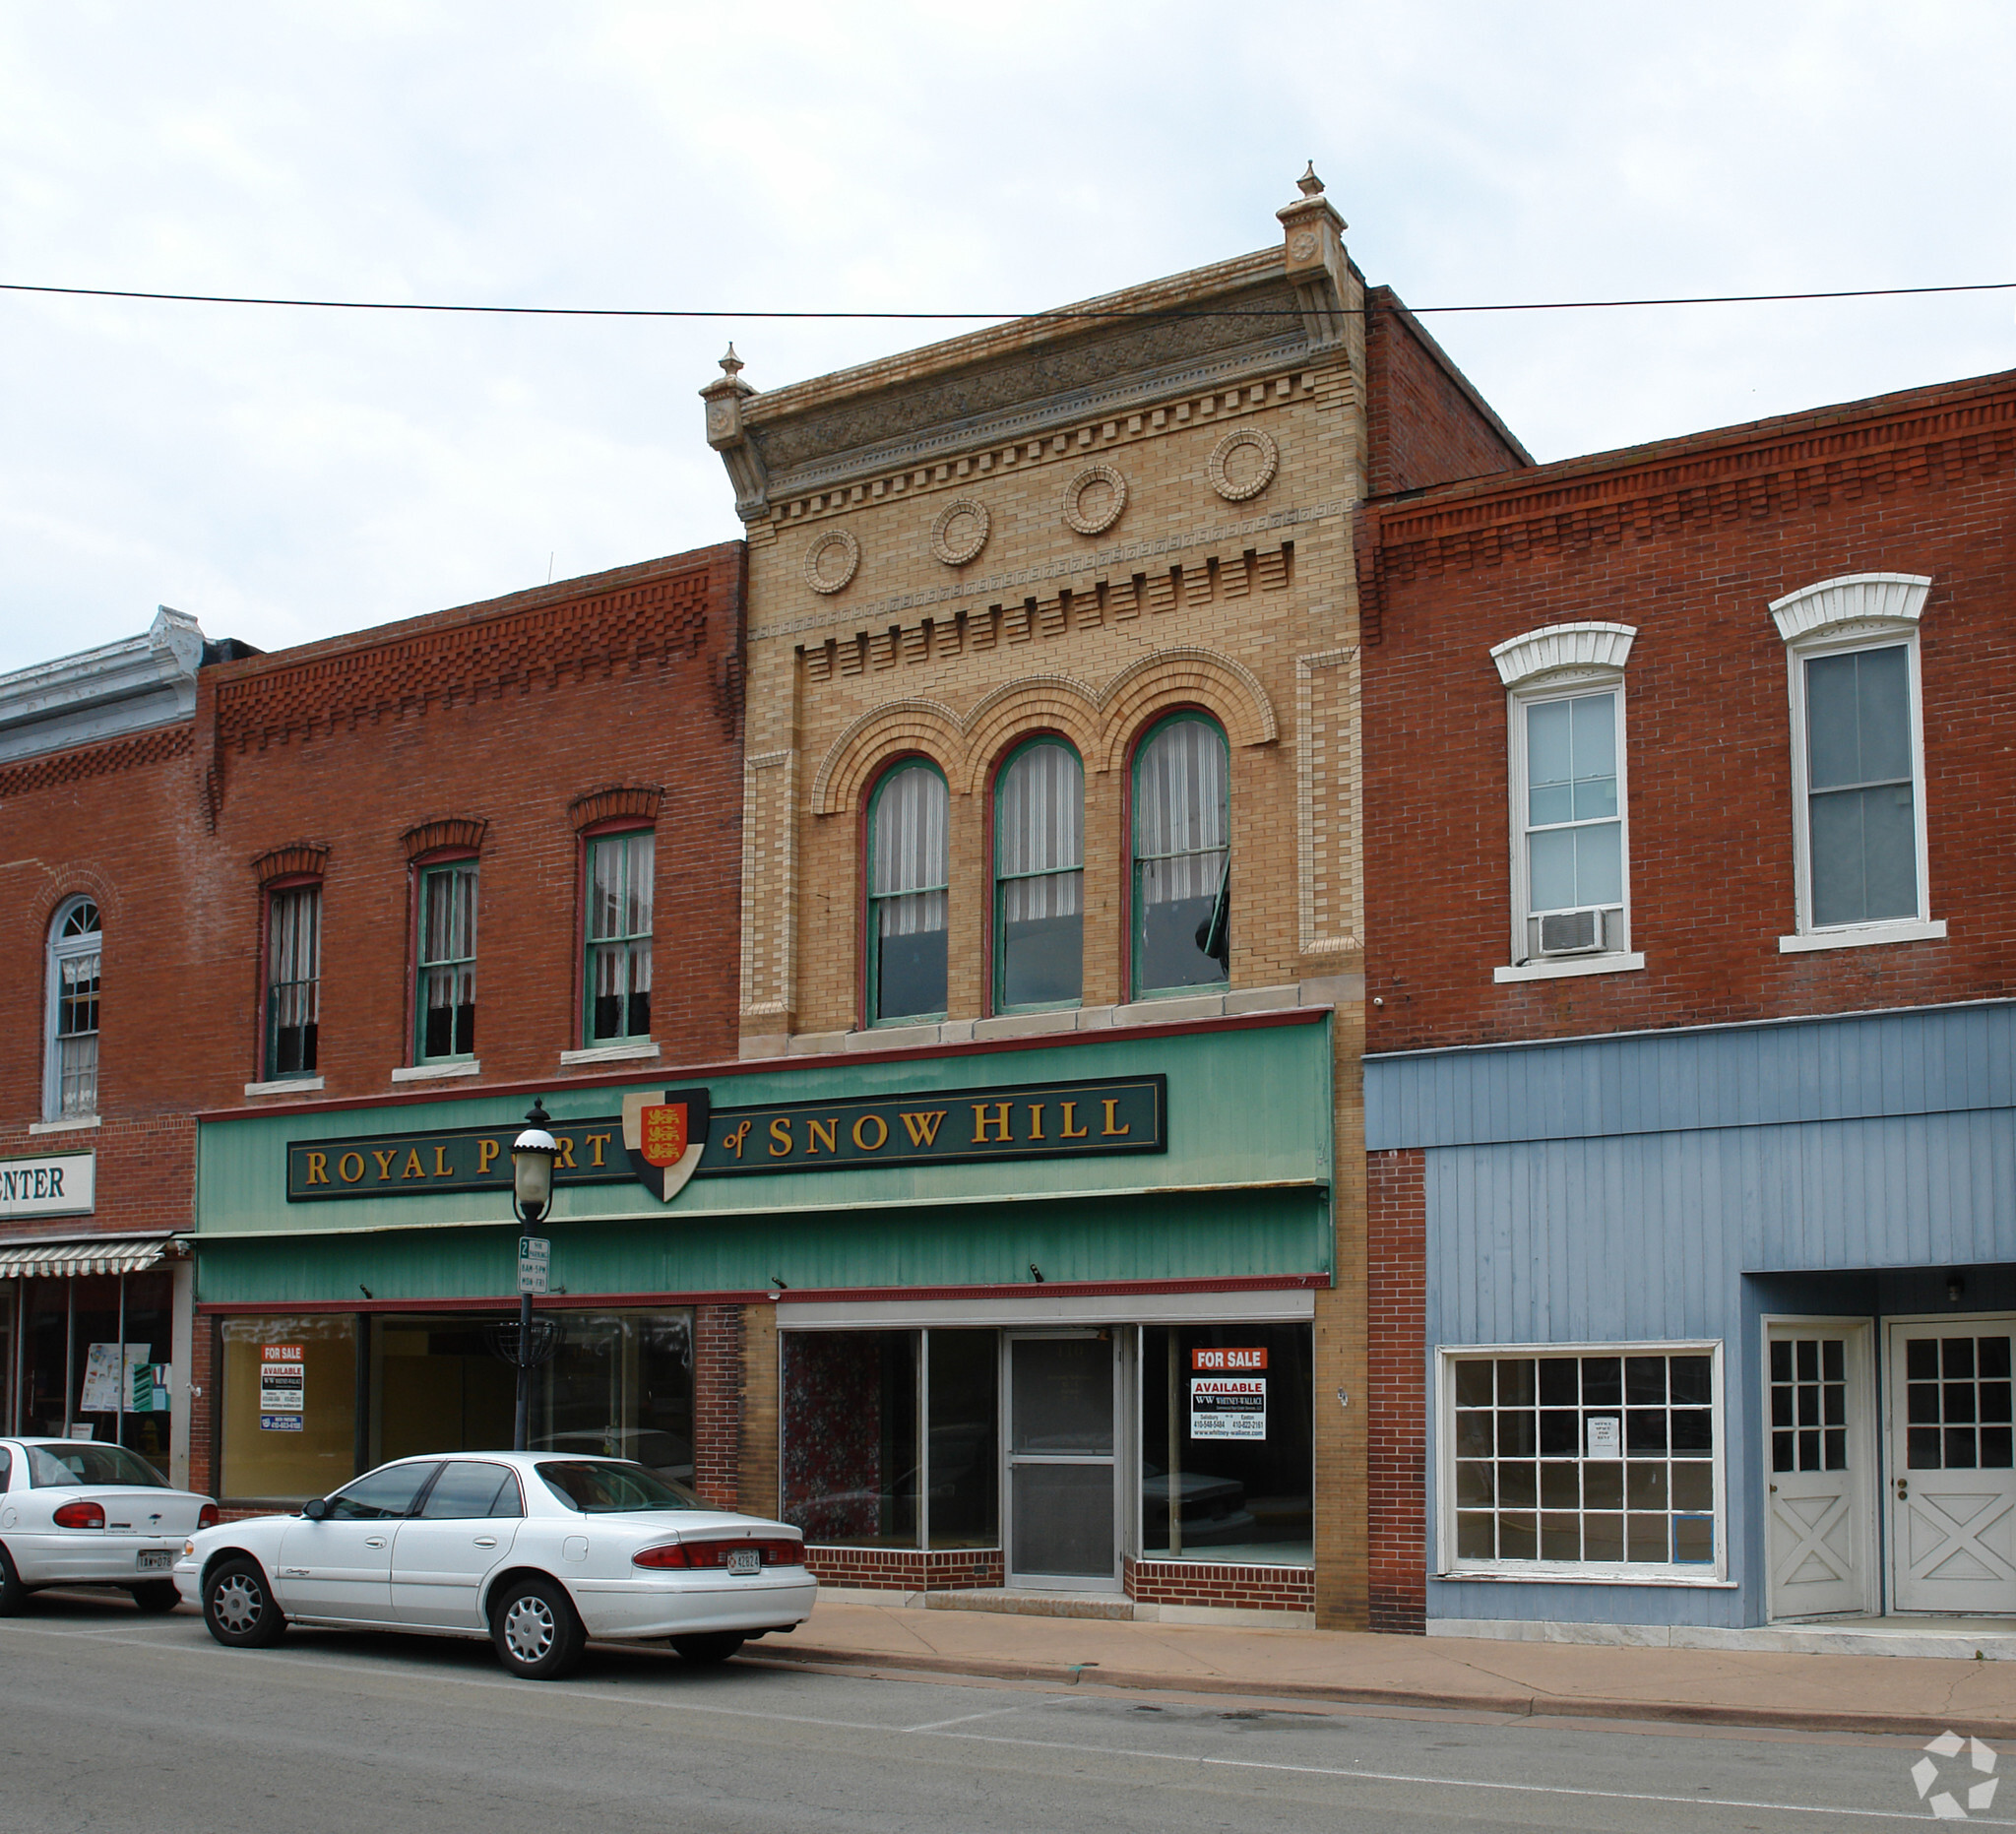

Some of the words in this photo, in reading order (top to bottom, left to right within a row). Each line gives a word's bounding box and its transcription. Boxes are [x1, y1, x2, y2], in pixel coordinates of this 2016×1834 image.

[305, 1144, 455, 1185] ROYAL
[476, 1132, 612, 1174] PRT
[722, 1119, 752, 1159] of
[768, 1108, 949, 1158] SNOW
[971, 1099, 1131, 1143] HILL
[0, 1167, 65, 1201] NTER
[522, 1241, 528, 1255] 2
[264, 1347, 281, 1360] FOR
[282, 1347, 301, 1360] SALE
[1197, 1352, 1225, 1367] FOR
[1227, 1351, 1262, 1367] SALE
[1195, 1383, 1262, 1392] AVAILABLE
[1194, 1395, 1215, 1404] WW
[738, 1555, 758, 1567] 42824
